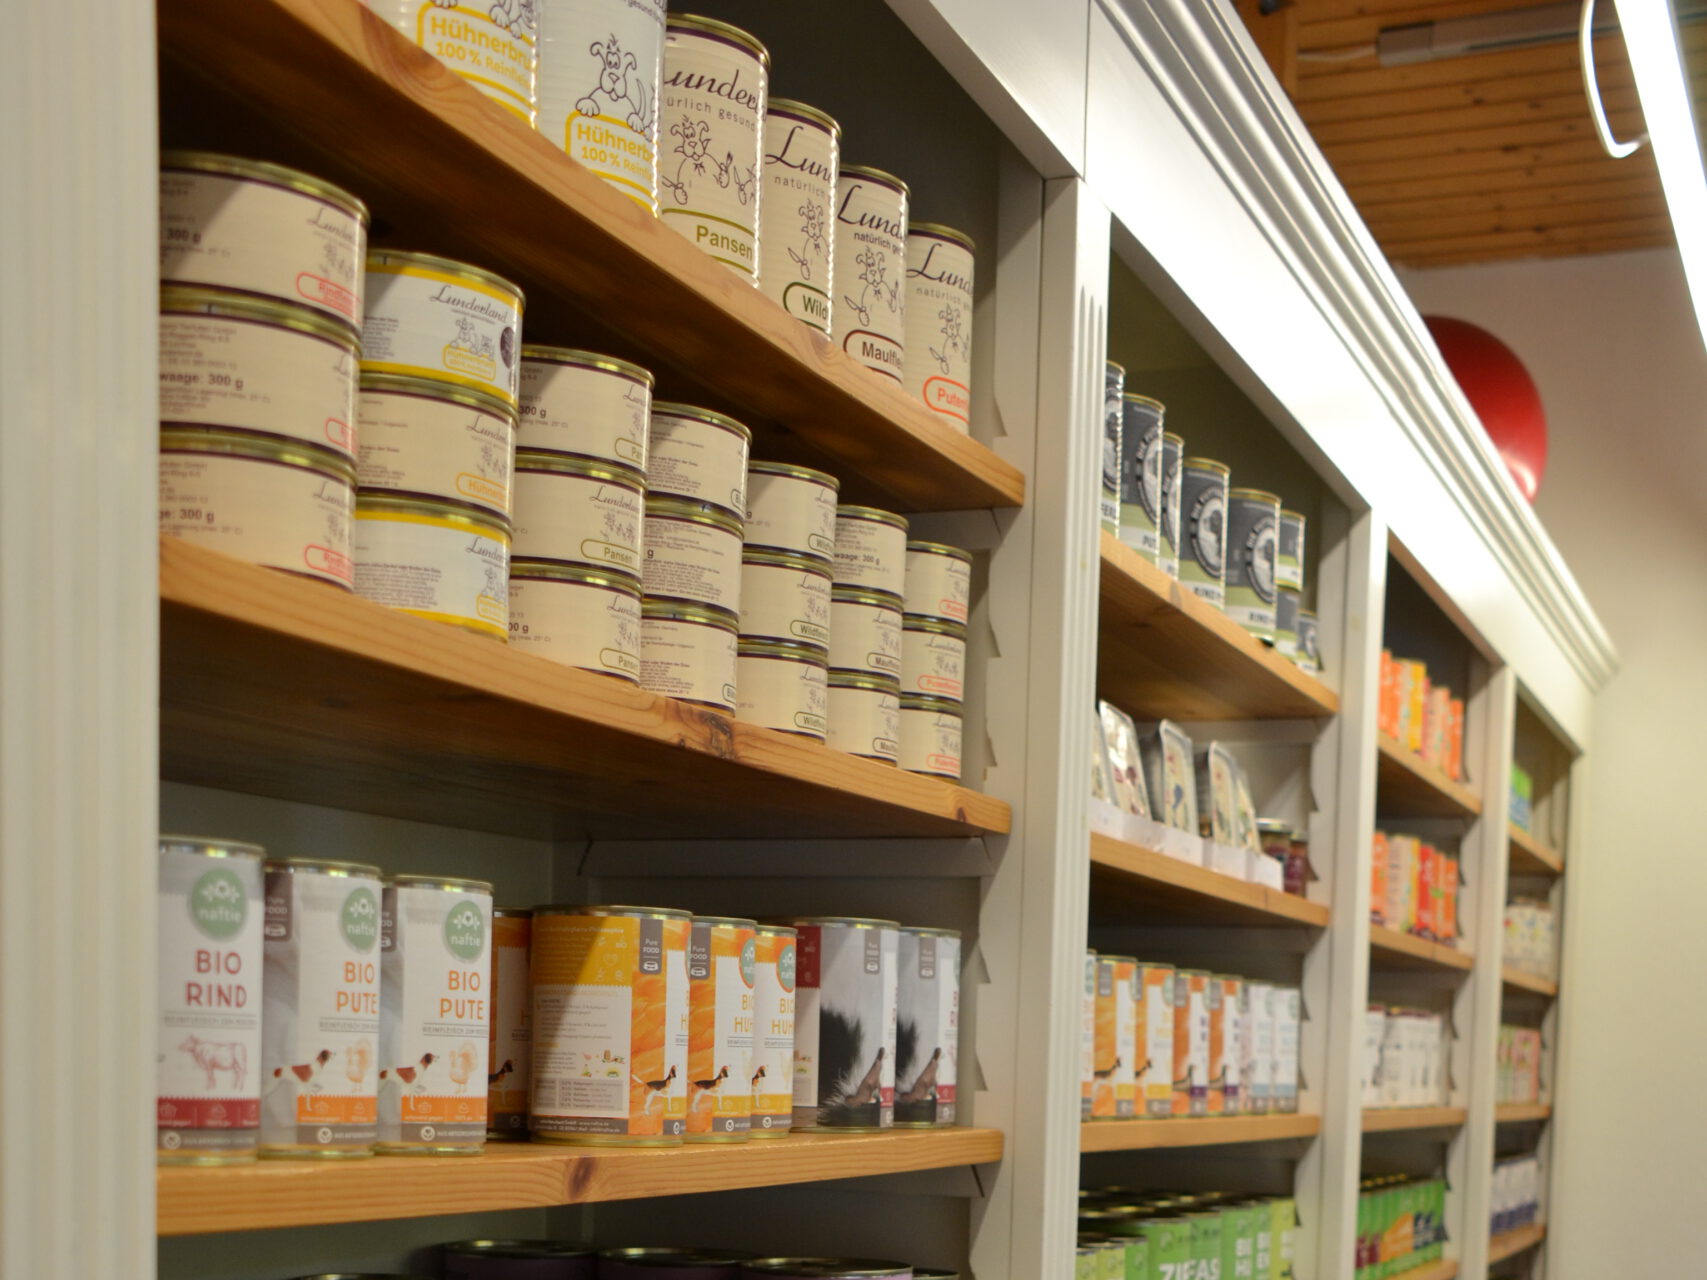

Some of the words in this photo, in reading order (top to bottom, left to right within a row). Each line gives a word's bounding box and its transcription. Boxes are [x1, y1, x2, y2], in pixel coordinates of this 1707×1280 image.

[667, 96, 711, 113] ürlich
[718, 107, 758, 132] gesund
[695, 225, 753, 261] Pansen
[429, 285, 509, 323] Lunderland
[208, 373, 231, 386] 300
[235, 378, 243, 390] g
[180, 508, 202, 520] 300
[206, 511, 215, 523] g
[200, 905, 241, 922] naftie
[450, 933, 481, 948] naftie
[643, 946, 660, 954] FOOD
[195, 949, 241, 975] BIO
[344, 961, 375, 985] BIO
[448, 970, 480, 991] BIO
[185, 982, 247, 1009] RIND
[336, 990, 378, 1014] PUTE
[439, 997, 485, 1021] PUTE
